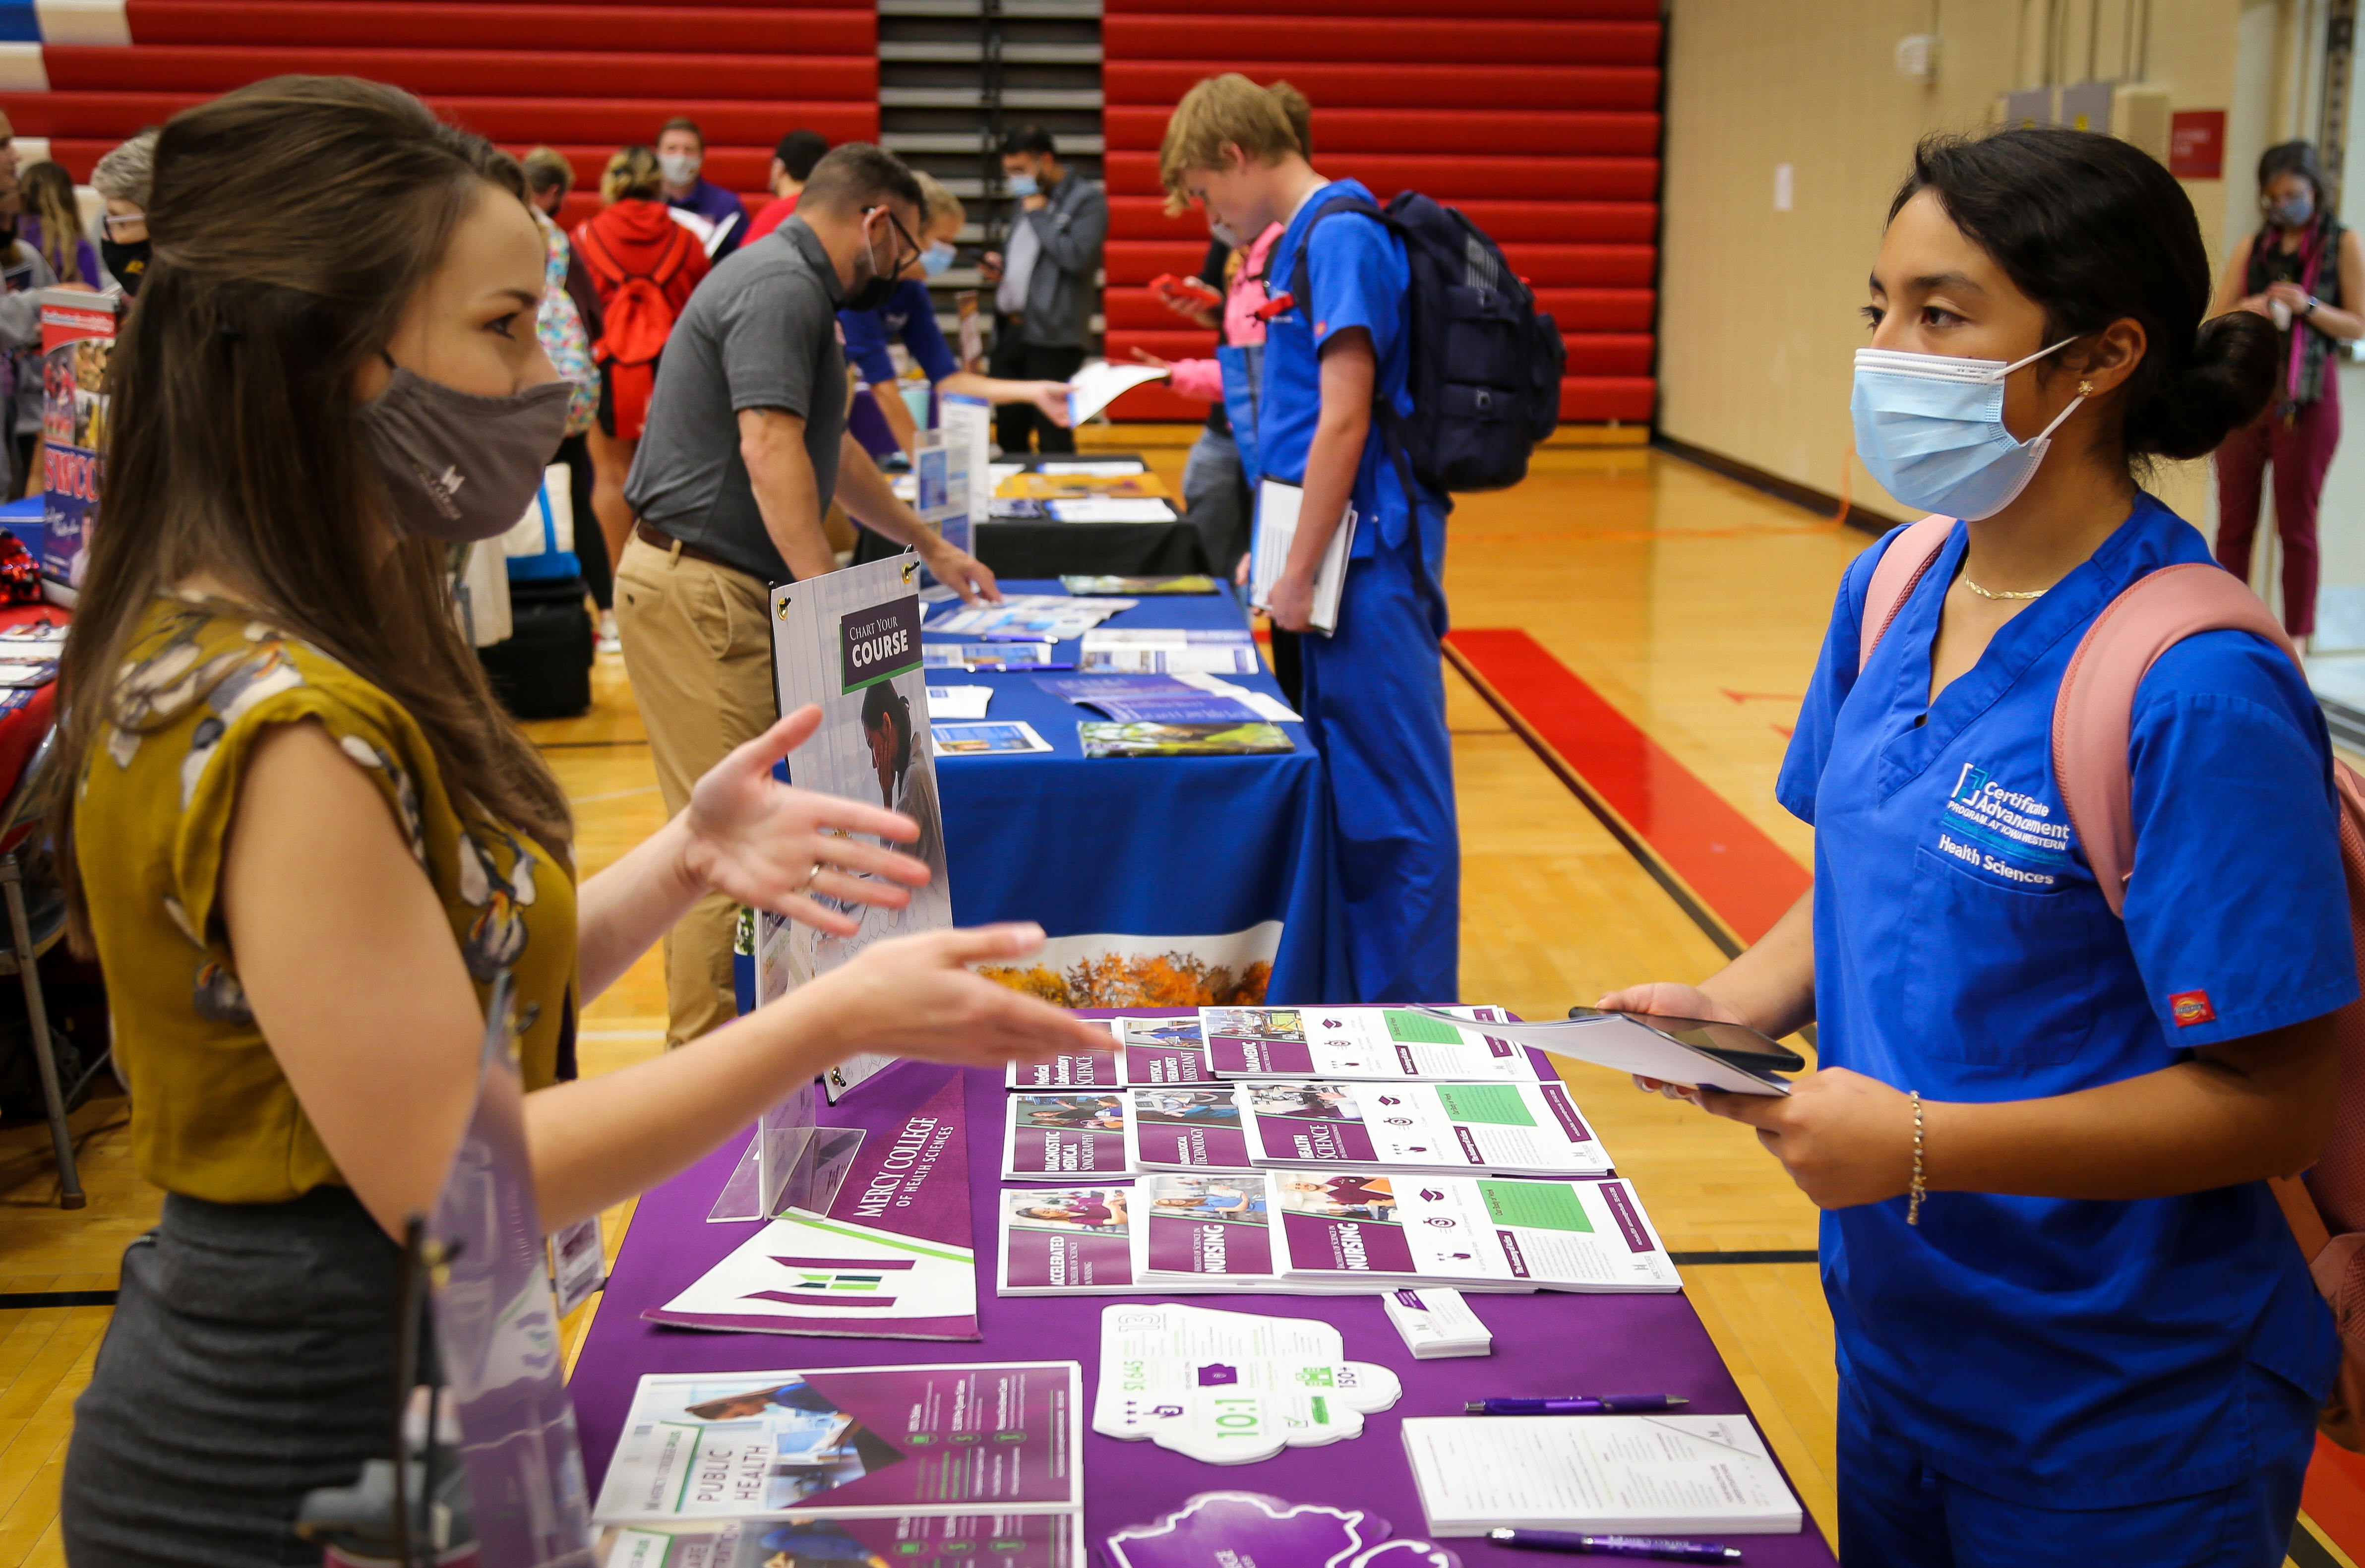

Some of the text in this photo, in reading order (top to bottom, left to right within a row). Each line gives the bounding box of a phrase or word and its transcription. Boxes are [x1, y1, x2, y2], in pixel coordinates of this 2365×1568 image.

[849, 616, 898, 641] CHART YOUR
[852, 629, 909, 667] COURSE
[1976, 794, 2070, 840] Advancement
[1984, 780, 2050, 818] Certificate
[1947, 800, 2066, 851] PROGRAM AT IOWA WESTERN
[1939, 834, 1981, 867] Health
[1982, 855, 2054, 885] Sciences
[1034, 1063, 1050, 1085] Medical
[1054, 1055, 1073, 1086] Laboratory
[1074, 1055, 1095, 1085] SCIENCE
[1182, 1051, 1198, 1082] ASSISTANT
[1243, 1042, 1262, 1072] PARAMEDIC
[1044, 1131, 1061, 1171] DIAGNOSTIC
[1062, 1143, 1078, 1171] MEDICAL
[1080, 1133, 1095, 1171] SONOGRAPHY
[1191, 1127, 1209, 1165] TECHNOLOGY
[1293, 1135, 1315, 1158] HEALTH
[1310, 1124, 1338, 1159] SCIENCE
[853, 1116, 939, 1217] MERCY COLLEGE
[896, 1126, 954, 1207] OF HEALTH SCIENCES
[1049, 1235, 1066, 1285] ACCELERATED
[1203, 1224, 1225, 1273] NURSING
[1336, 1222, 1370, 1270] NURSING
[1123, 1360, 1148, 1391] $1,645
[1337, 1366, 1357, 1388] 150+
[1215, 1399, 1259, 1438] 10:1
[696, 1449, 733, 1502] PUBLIC
[734, 1444, 770, 1501] HEALTH
